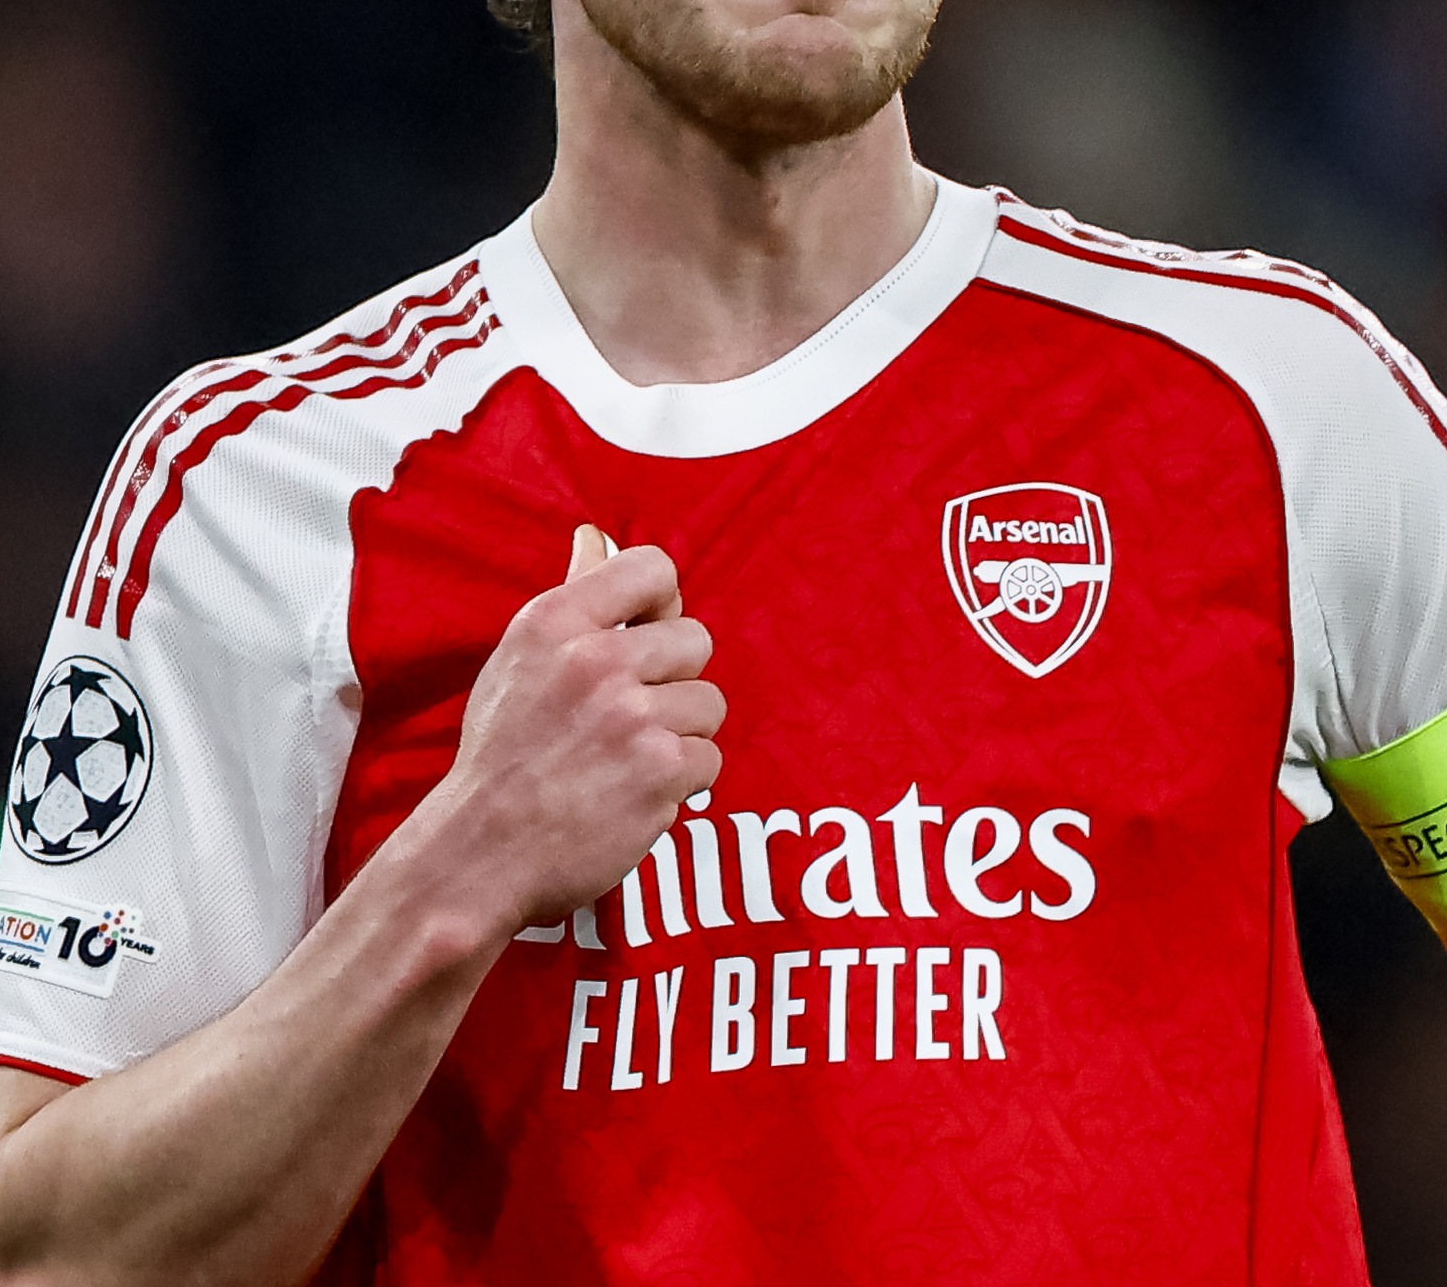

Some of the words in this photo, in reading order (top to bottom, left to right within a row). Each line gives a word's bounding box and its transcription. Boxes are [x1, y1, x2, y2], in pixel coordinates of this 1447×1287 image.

[968, 515, 1088, 545] Arsenal
[513, 781, 1096, 951] mirates
[57, 916, 117, 968] 10
[120, 936, 155, 956] YEARS
[562, 964, 684, 1092] FLY
[710, 947, 1006, 1074] BETTER
